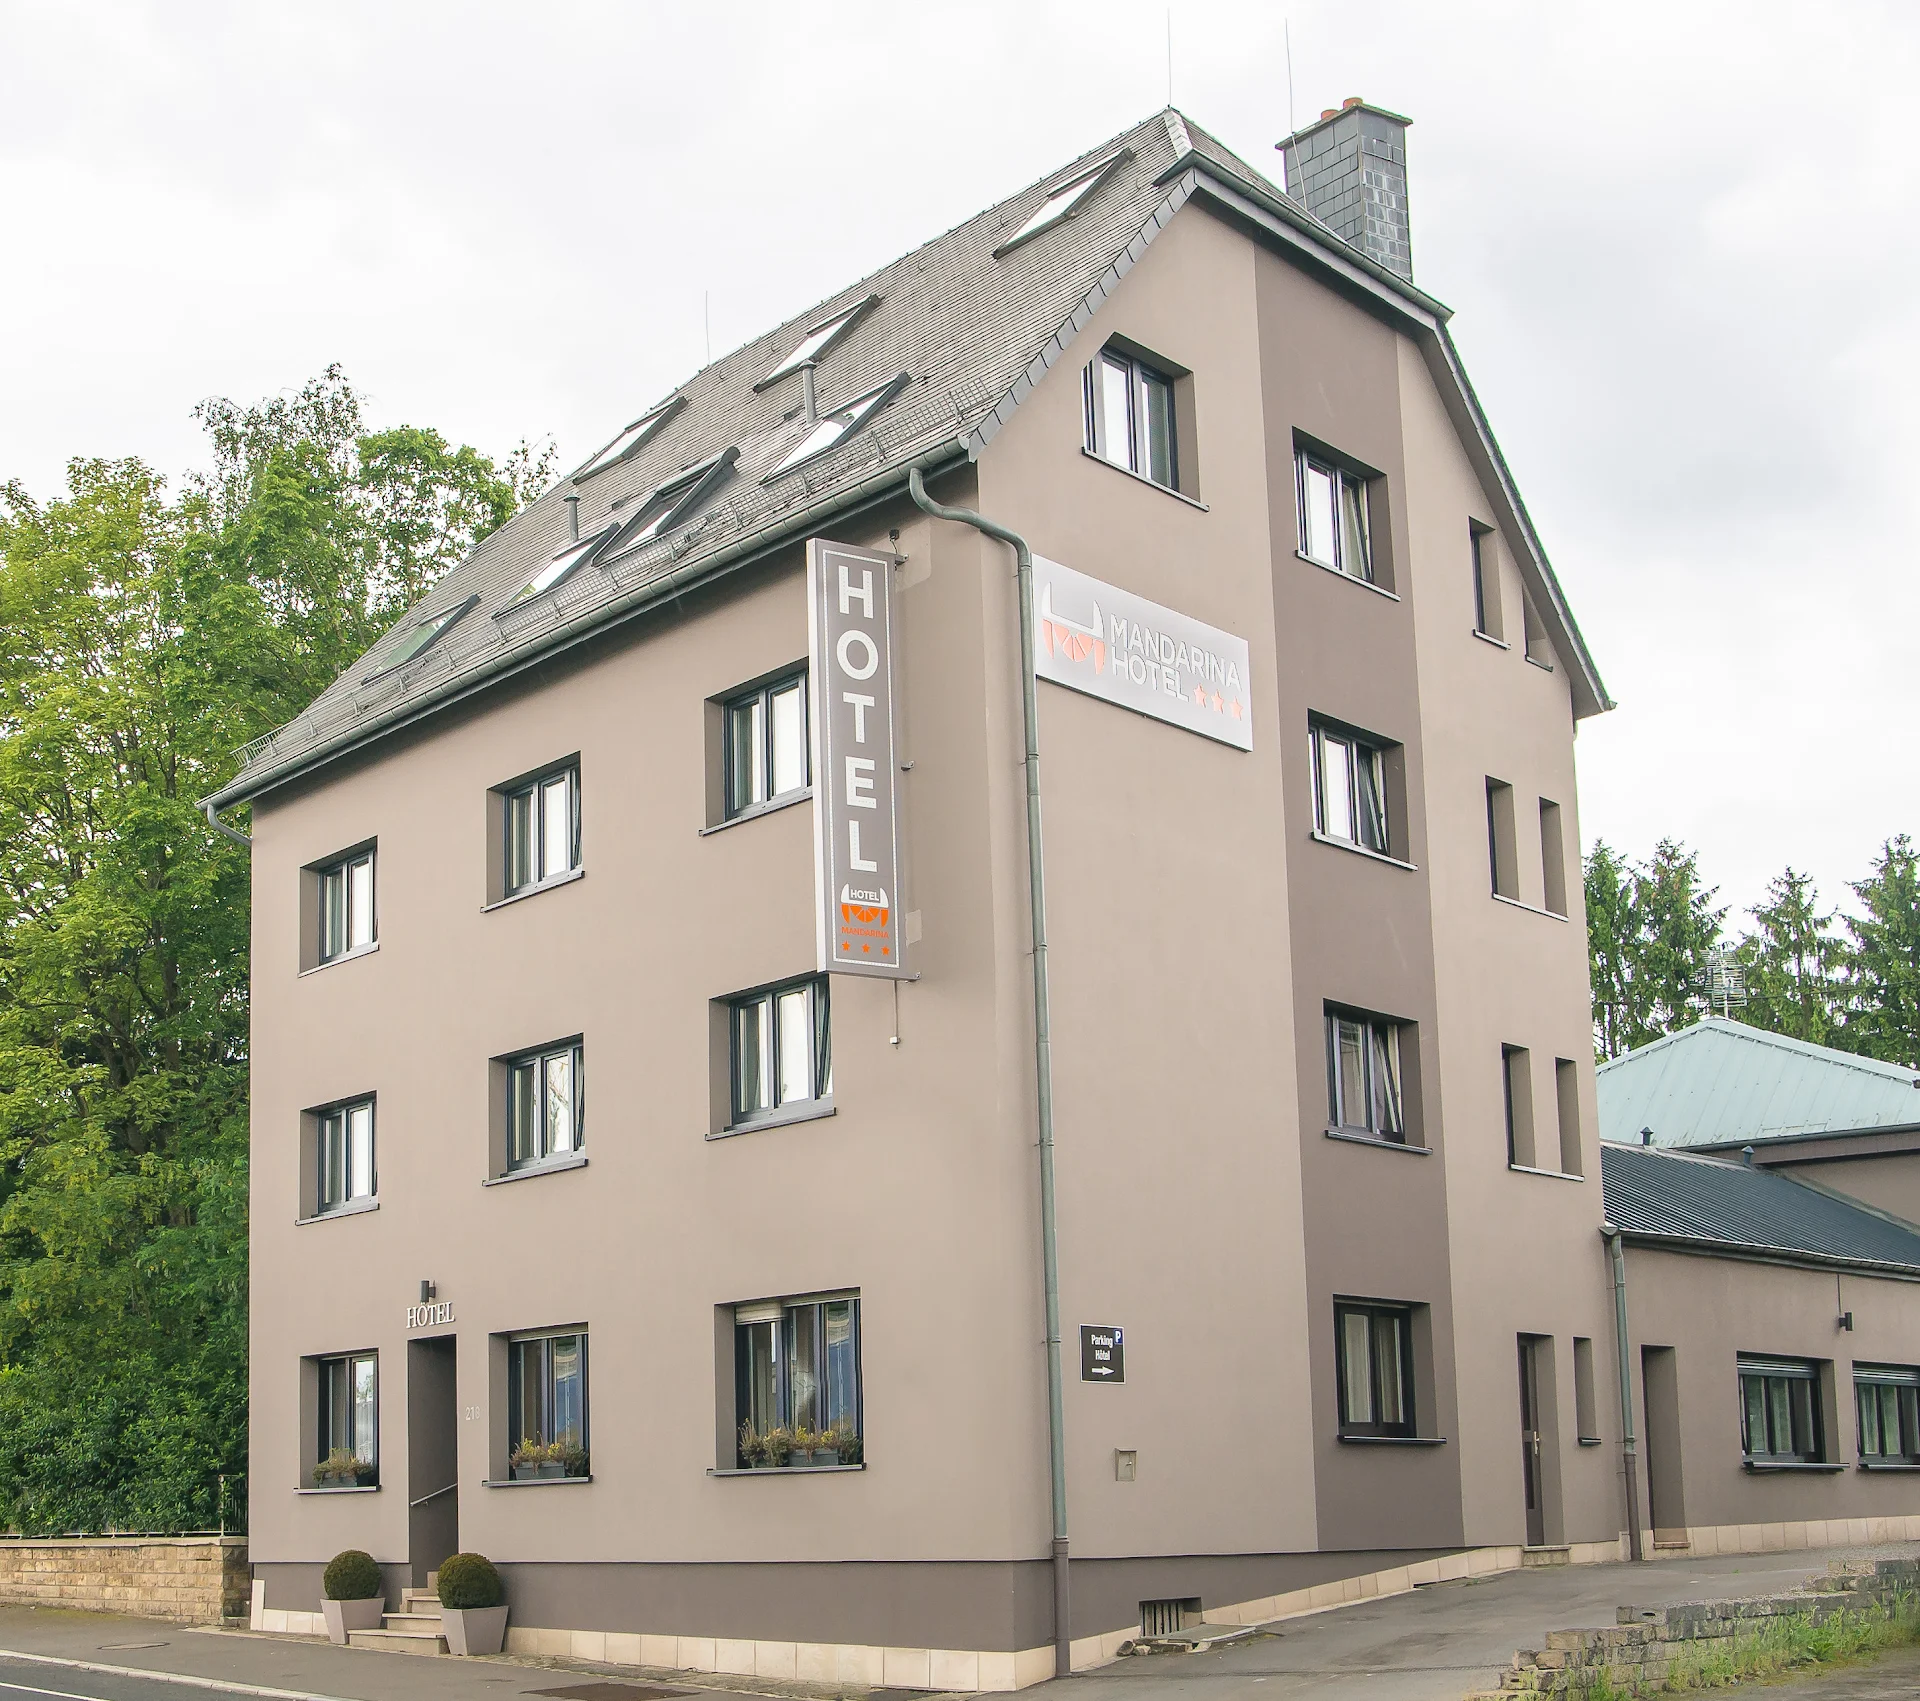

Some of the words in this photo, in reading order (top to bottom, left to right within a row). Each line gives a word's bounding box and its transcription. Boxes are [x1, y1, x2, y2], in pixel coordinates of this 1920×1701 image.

[1110, 613, 1242, 692] MANDARINA
[1111, 645, 1190, 702] HOTEL
[836, 566, 879, 873] HOTEL
[850, 889, 880, 902] HOTEL
[841, 926, 889, 939] MANDARINA
[1091, 1334, 1113, 1348] Parking
[1115, 1331, 1121, 1343] P
